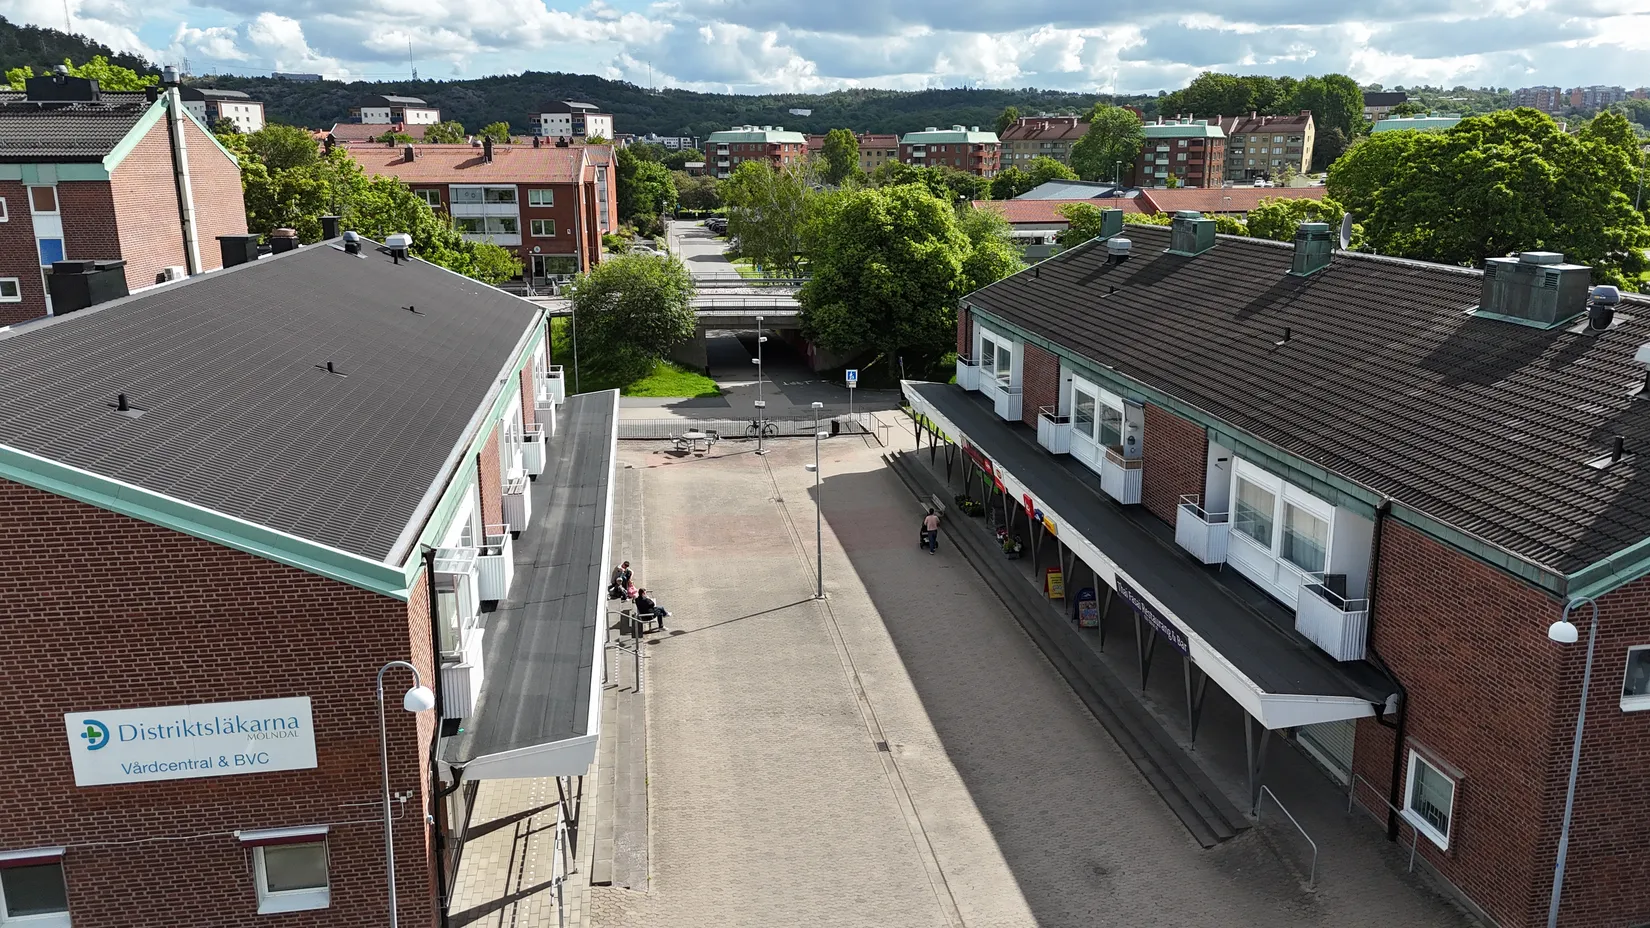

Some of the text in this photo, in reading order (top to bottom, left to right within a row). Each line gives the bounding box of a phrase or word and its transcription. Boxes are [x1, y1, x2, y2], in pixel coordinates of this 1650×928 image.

[1117, 580, 1128, 598] Thai
[1141, 602, 1172, 641] Restaurang
[1176, 634, 1188, 652] Bar
[118, 715, 300, 742] Distriktsläkarna
[121, 752, 270, 775] Vårdcentral & BVC
